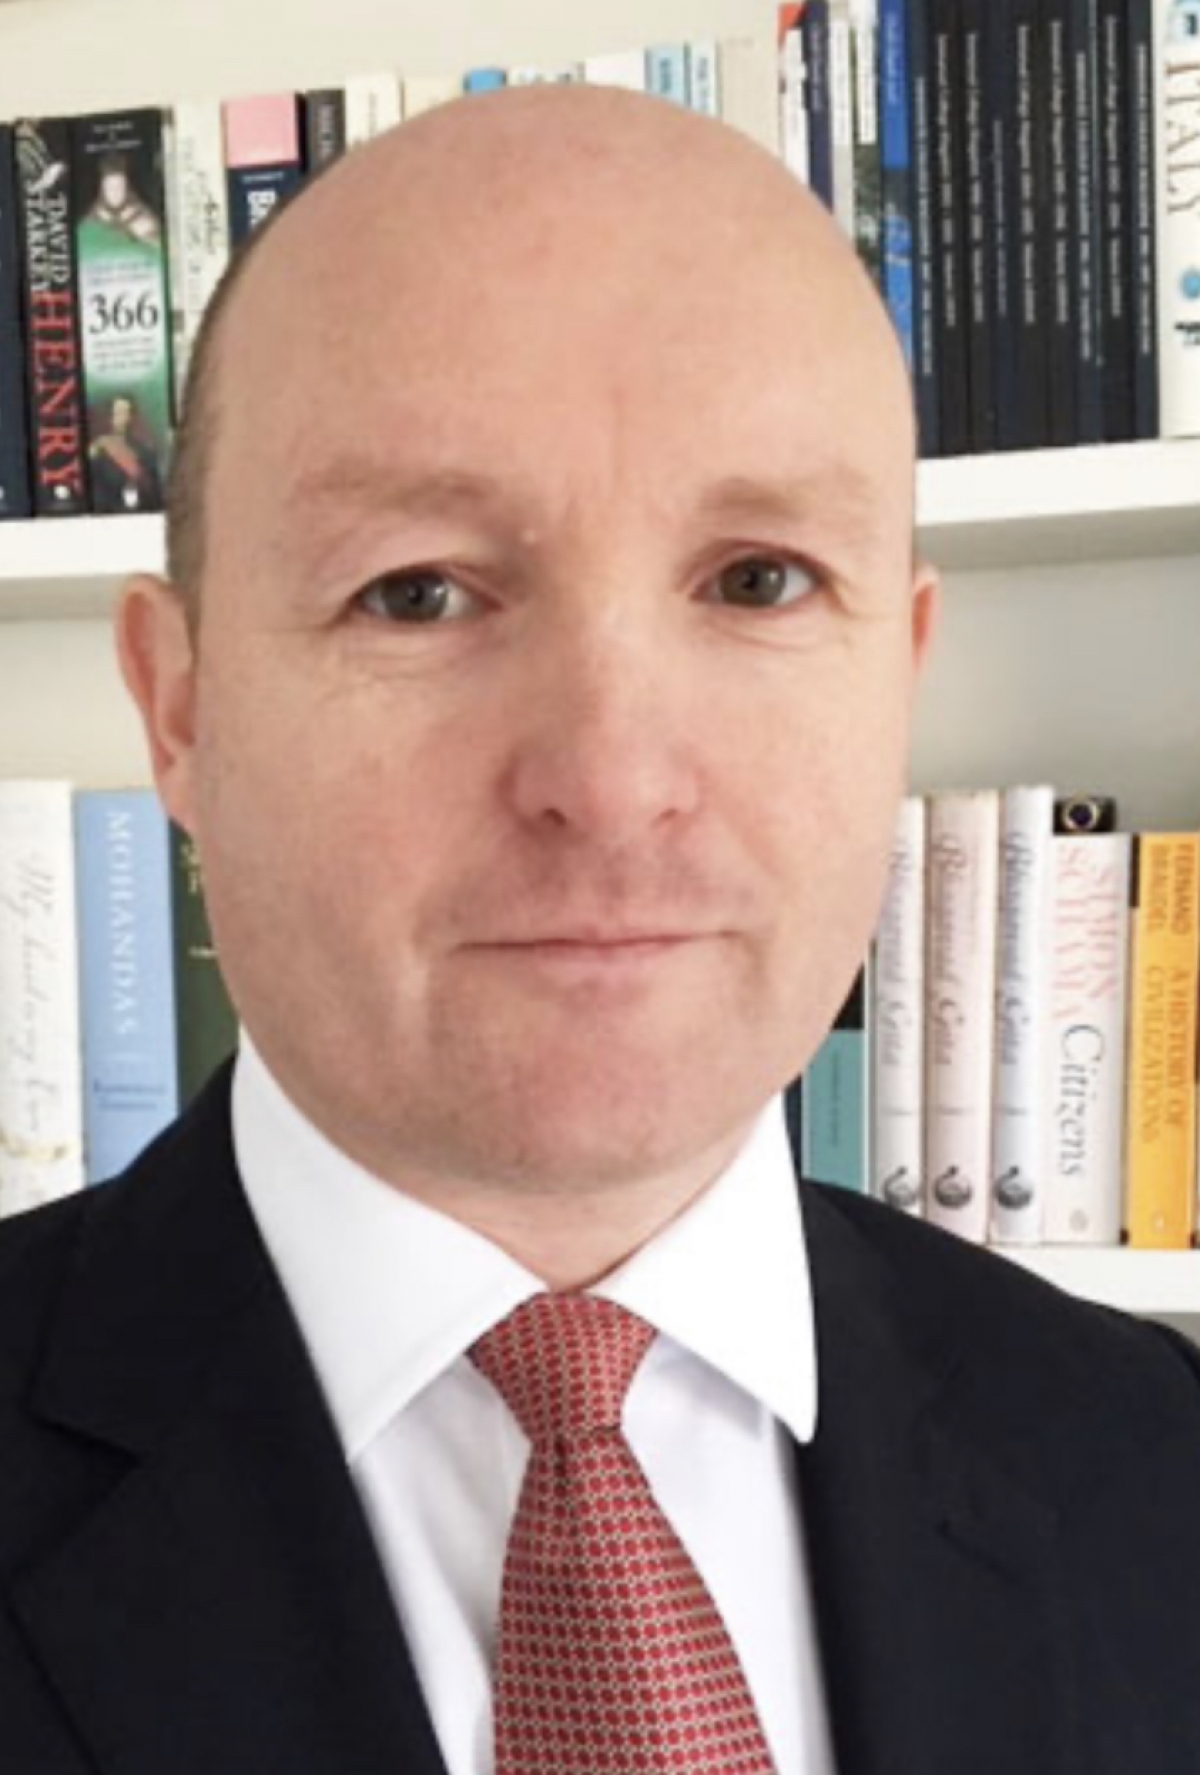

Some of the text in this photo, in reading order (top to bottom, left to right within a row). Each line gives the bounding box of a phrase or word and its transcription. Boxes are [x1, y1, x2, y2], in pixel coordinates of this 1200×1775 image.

[31, 289, 83, 493] HENRY
[87, 290, 159, 335] 366
[107, 810, 140, 1036] MOHANDAS
[1056, 1022, 1108, 1178] Citizens
